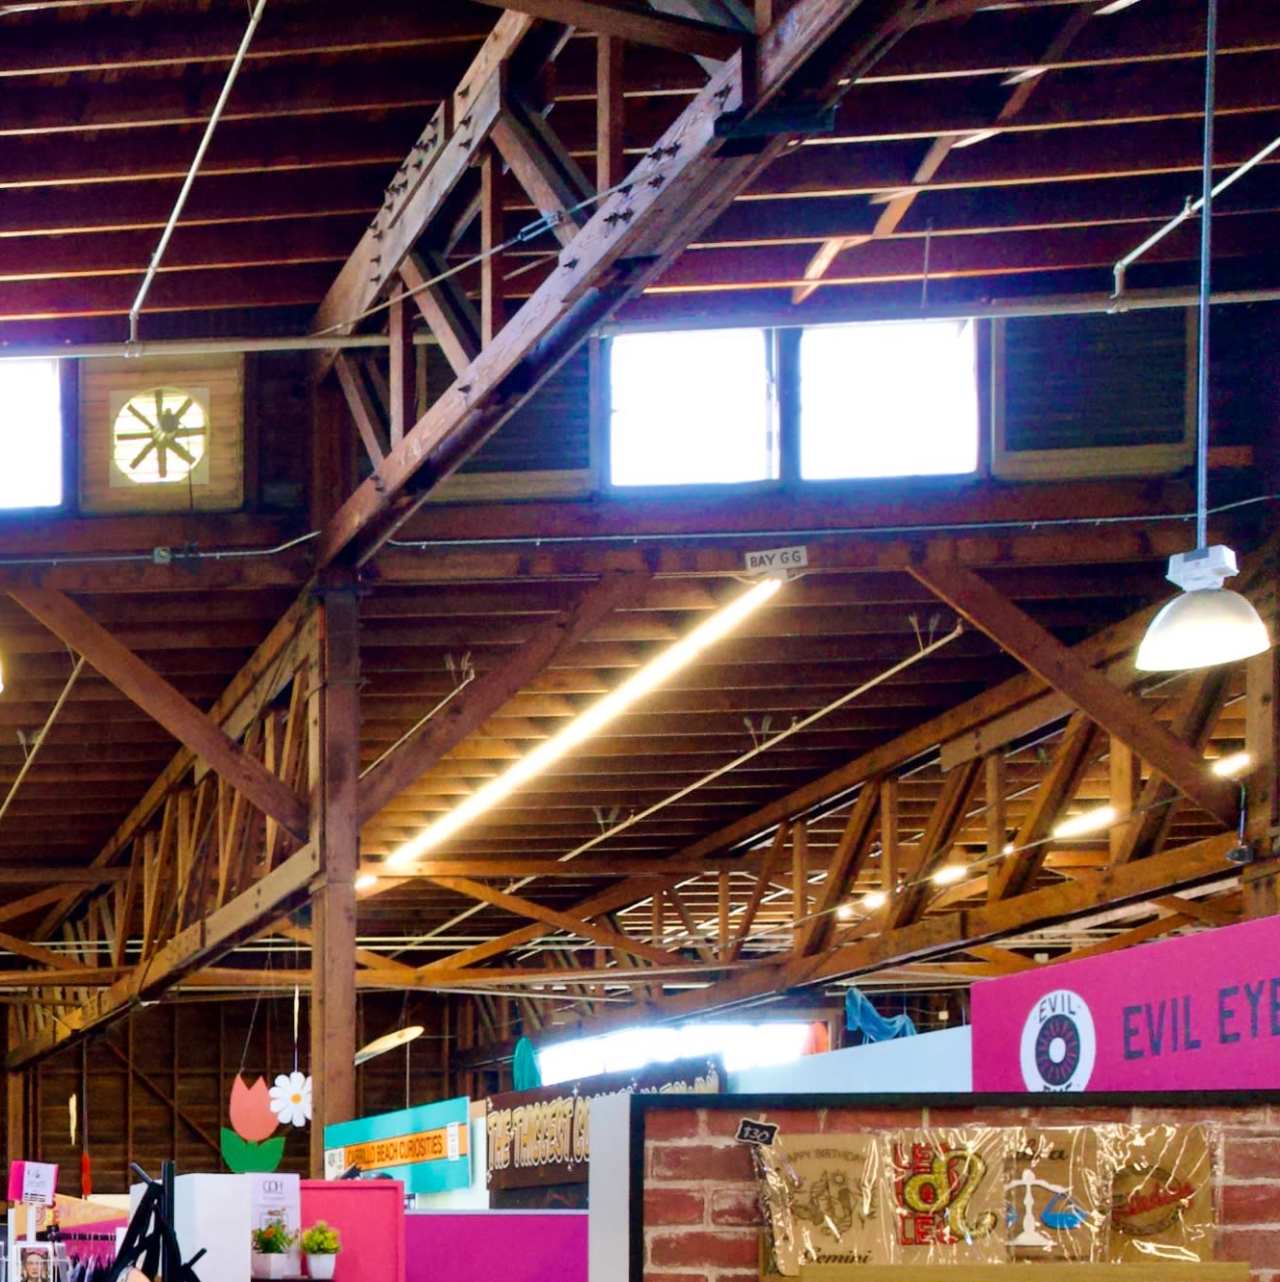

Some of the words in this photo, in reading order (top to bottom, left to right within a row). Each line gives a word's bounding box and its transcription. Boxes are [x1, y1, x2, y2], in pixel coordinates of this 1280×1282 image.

[750, 554, 776, 568] BAY
[1040, 994, 1078, 1023] EVIL
[1123, 996, 1202, 1060] EVIL
[487, 1107, 512, 1171] THE
[743, 1127, 771, 1142] $30
